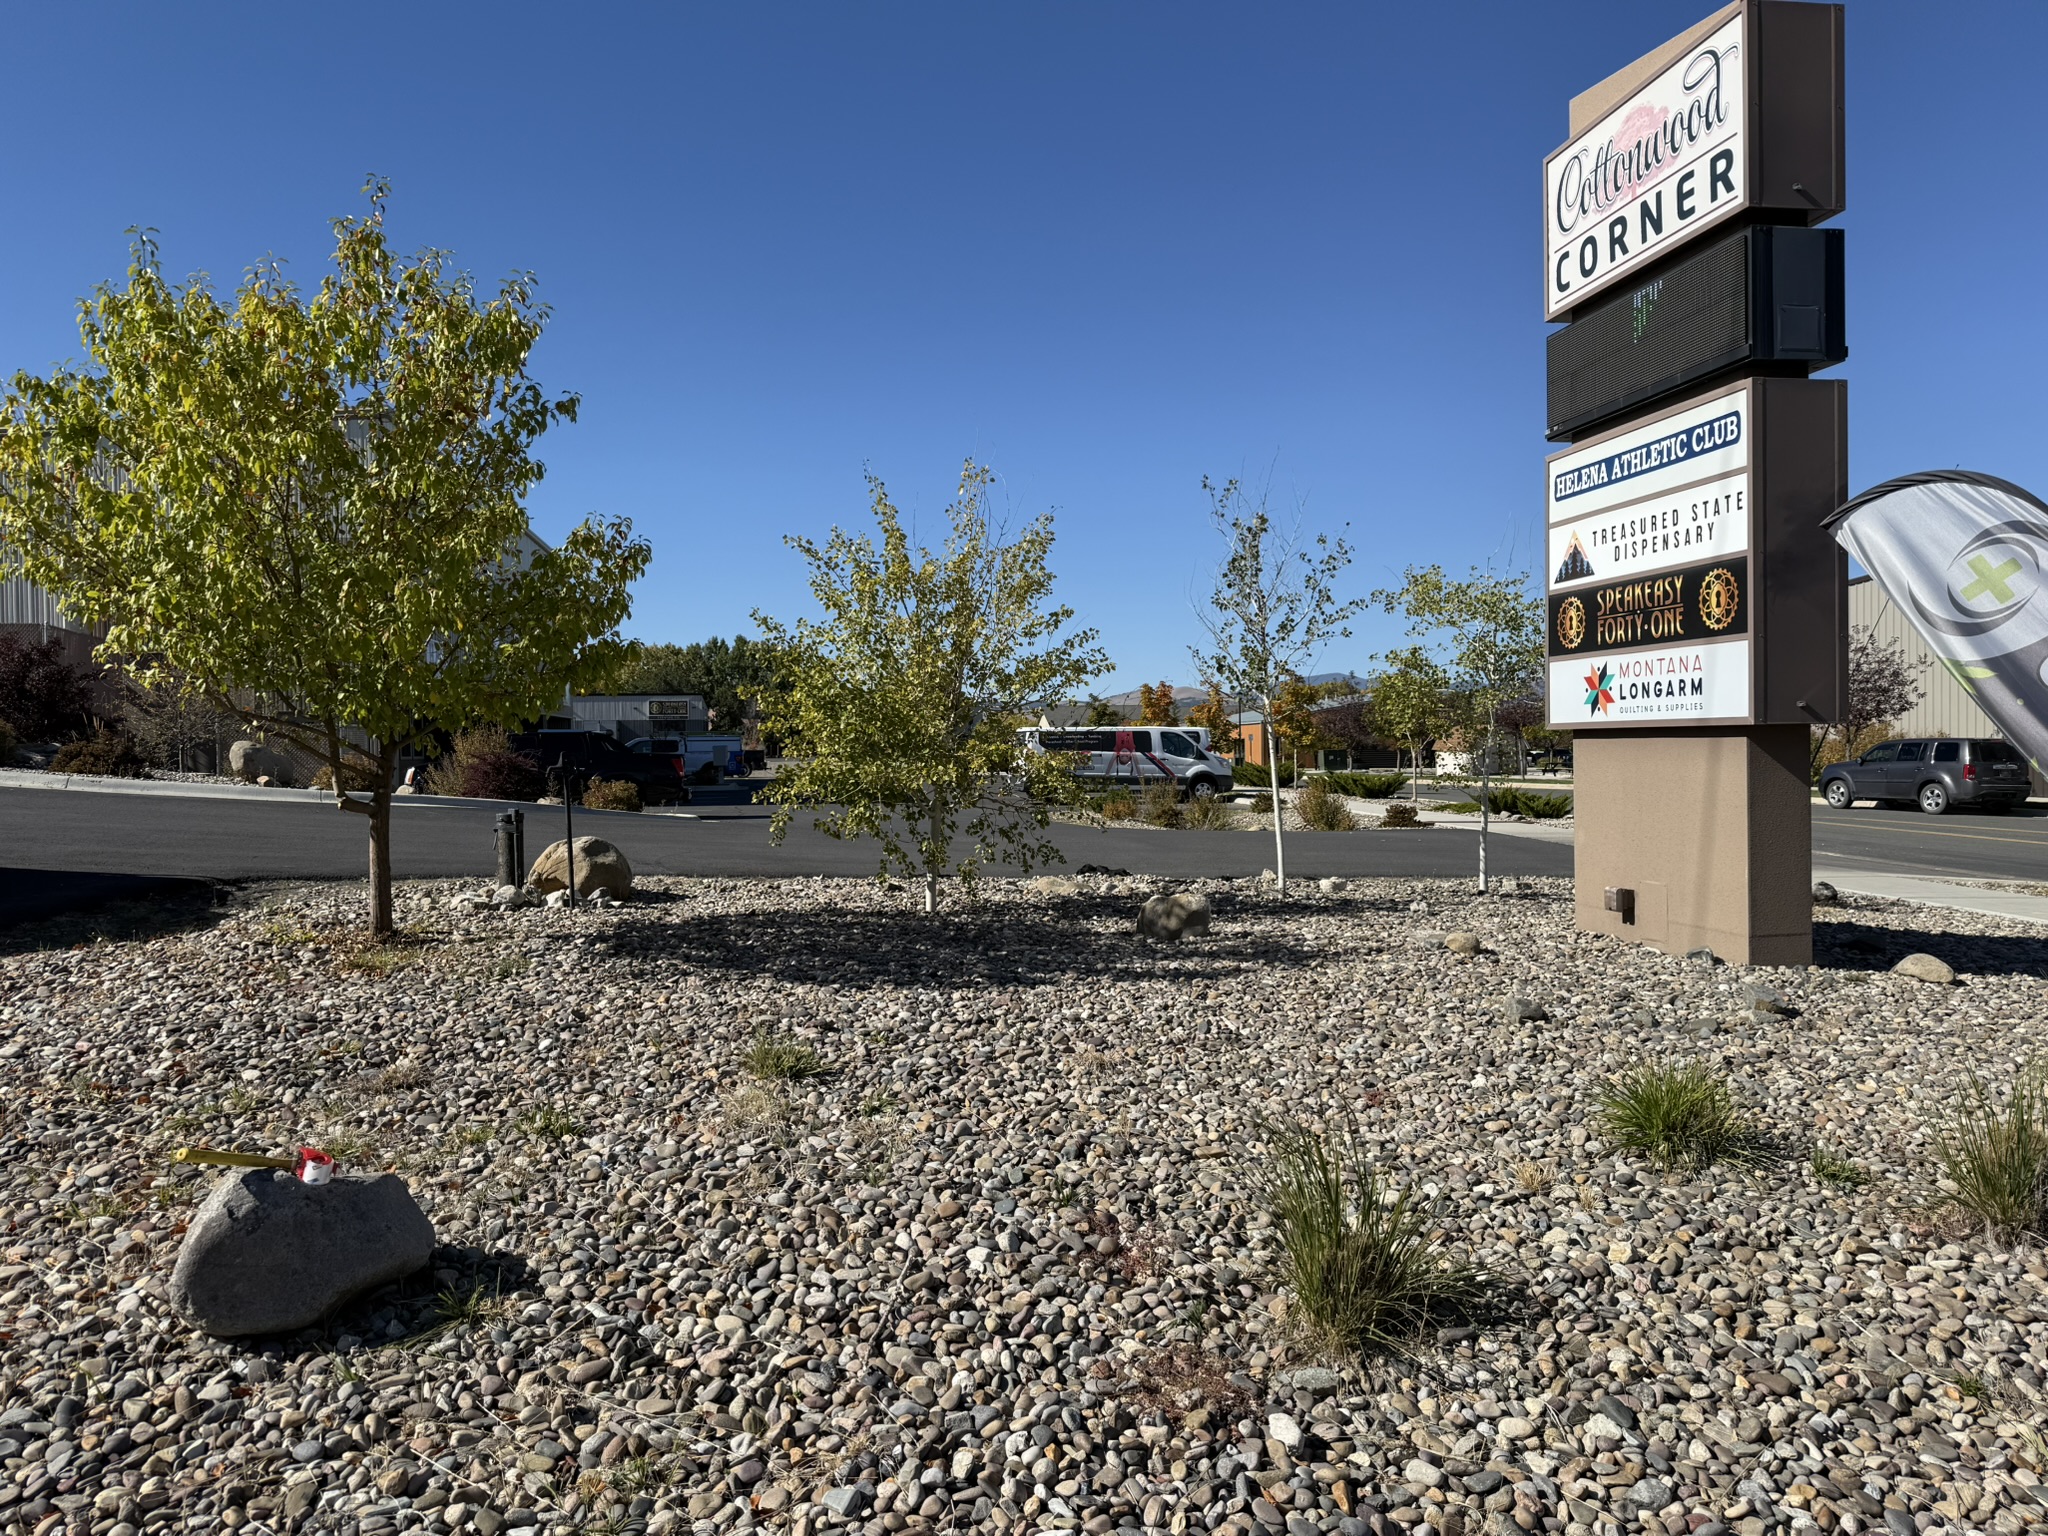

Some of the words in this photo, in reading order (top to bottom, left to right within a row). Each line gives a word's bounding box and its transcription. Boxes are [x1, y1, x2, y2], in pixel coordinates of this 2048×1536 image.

[1557, 42, 1740, 235] Cottonwood
[1556, 148, 1736, 293] CORNER
[1556, 462, 1608, 498] HELENA
[1611, 434, 1687, 480] ATHLETIC
[1692, 415, 1738, 453] CLUB
[1592, 509, 1679, 547] TREASURED
[1692, 491, 1744, 522] STATE
[1614, 522, 1715, 562] DISPENSARY
[1597, 574, 1683, 616] SPEAKEASY
[1619, 654, 1703, 679] MONTANA
[1619, 677, 1703, 700] LONGARM
[1619, 705, 1654, 714] QUILTING
[1657, 704, 1662, 712] &
[1665, 702, 1704, 712] SUPPLIES
